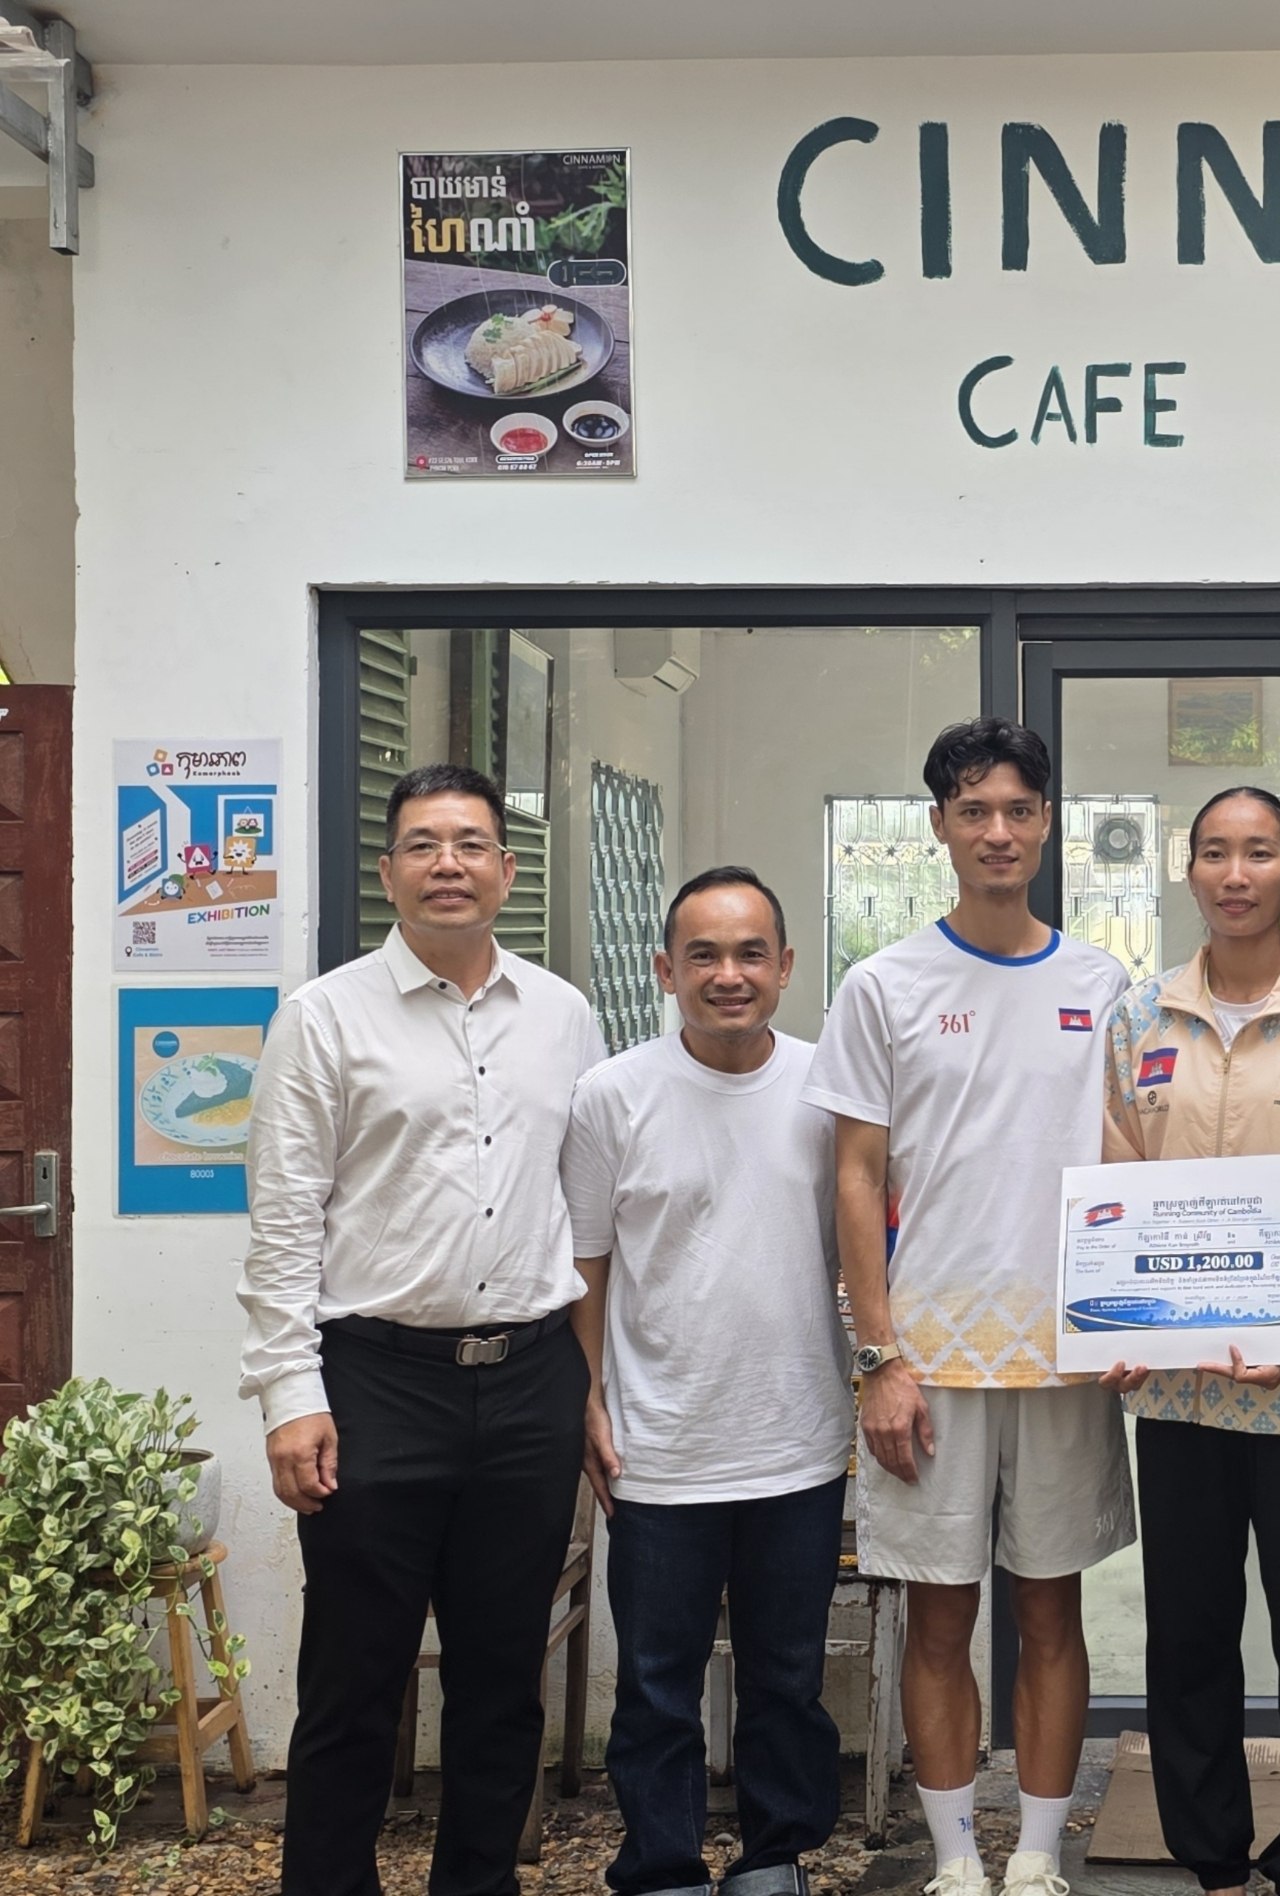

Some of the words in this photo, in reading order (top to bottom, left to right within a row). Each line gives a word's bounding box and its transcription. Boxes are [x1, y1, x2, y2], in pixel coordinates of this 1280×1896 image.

[957, 355, 1186, 448] CAFE
[187, 904, 270, 924] EXHIBITION
[1152, 1210, 1181, 1218] Running
[1181, 1209, 1218, 1217] Community
[1148, 1256, 1183, 1271] USD
[1187, 1254, 1254, 1272] 1,200.00
[958, 1816, 972, 1832] 36
